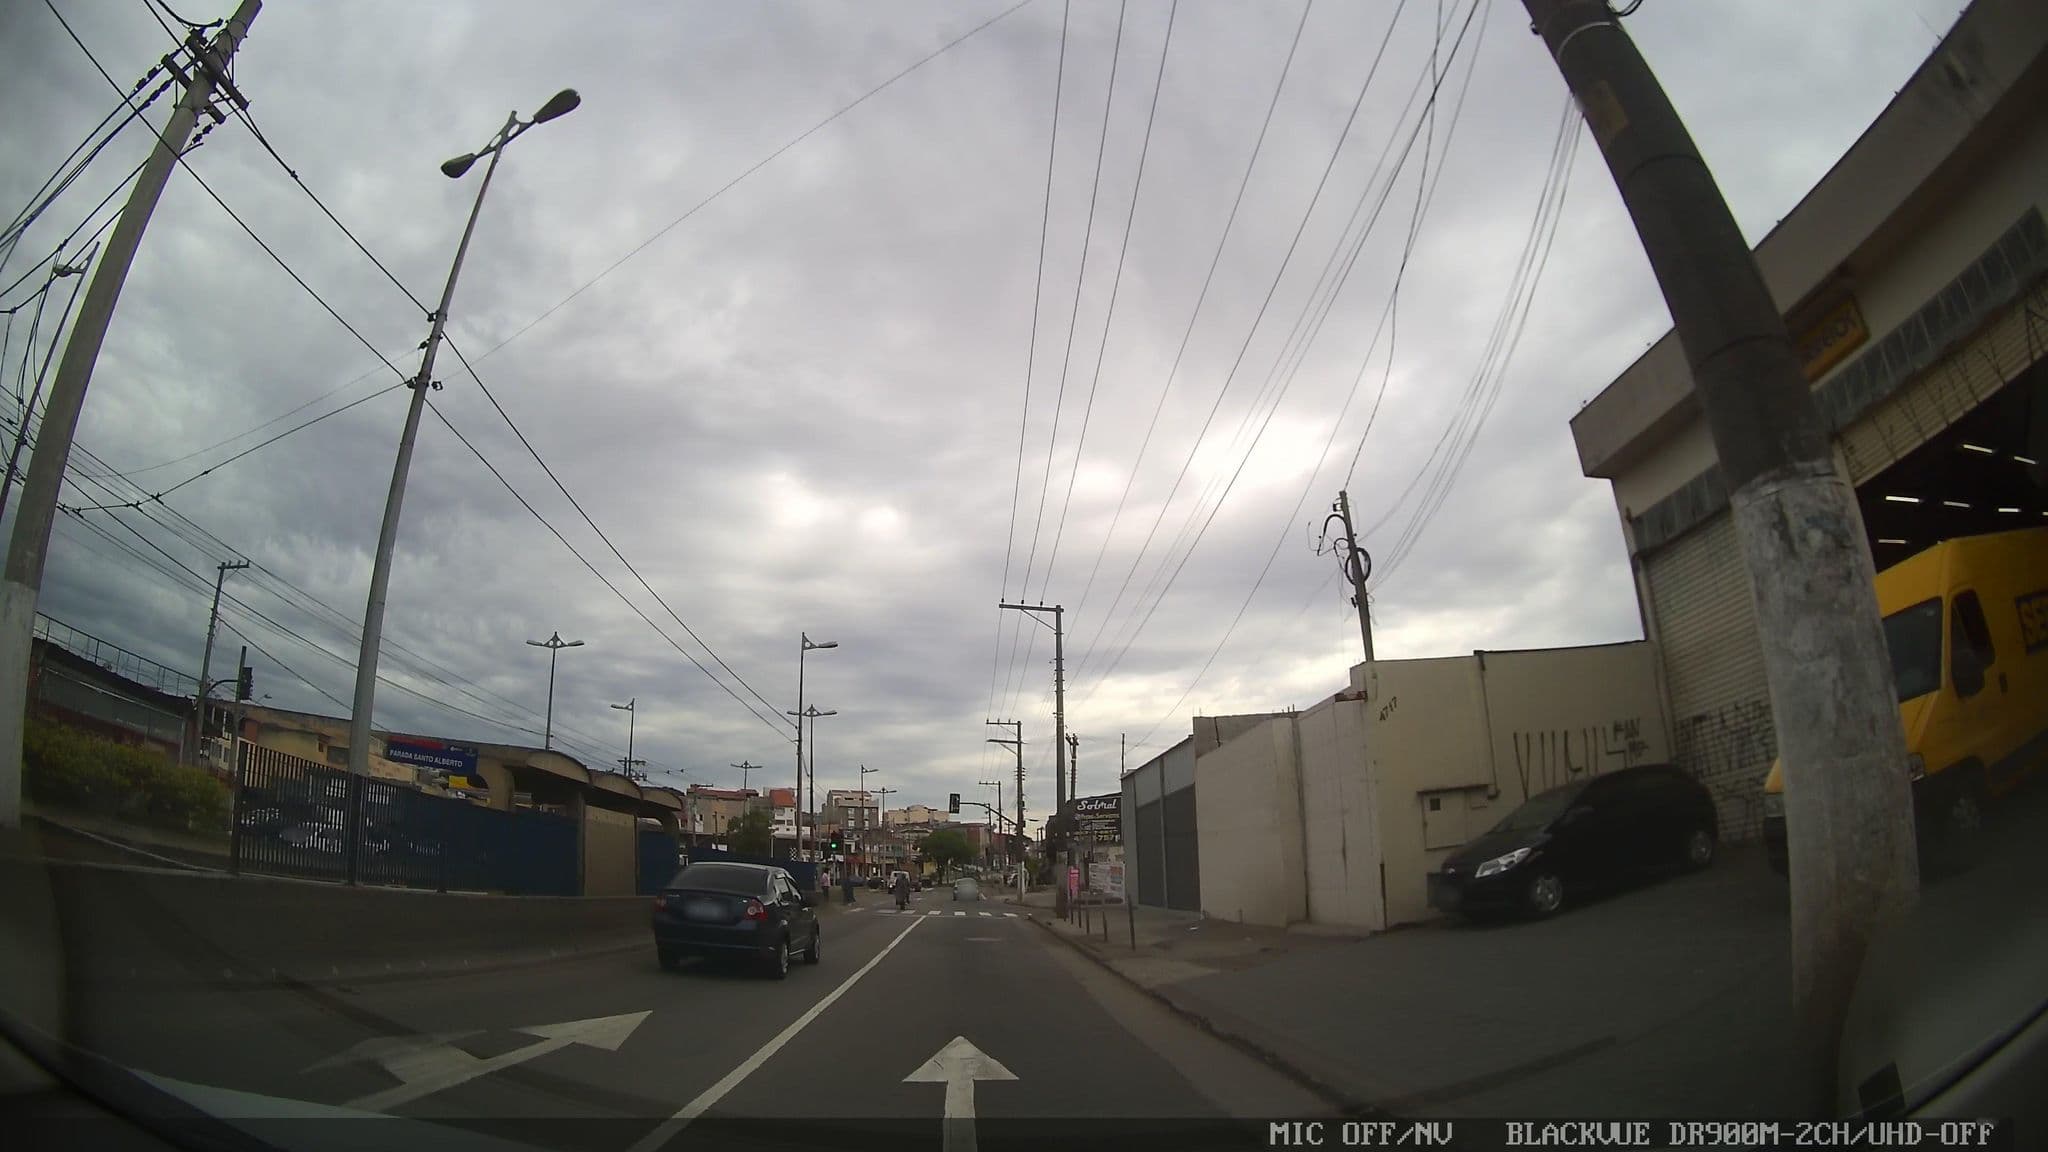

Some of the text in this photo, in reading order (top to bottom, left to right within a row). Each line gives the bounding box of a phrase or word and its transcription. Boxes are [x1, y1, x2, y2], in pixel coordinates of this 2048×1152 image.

[389, 749, 463, 768] PARADA SANTO ALBERTO
